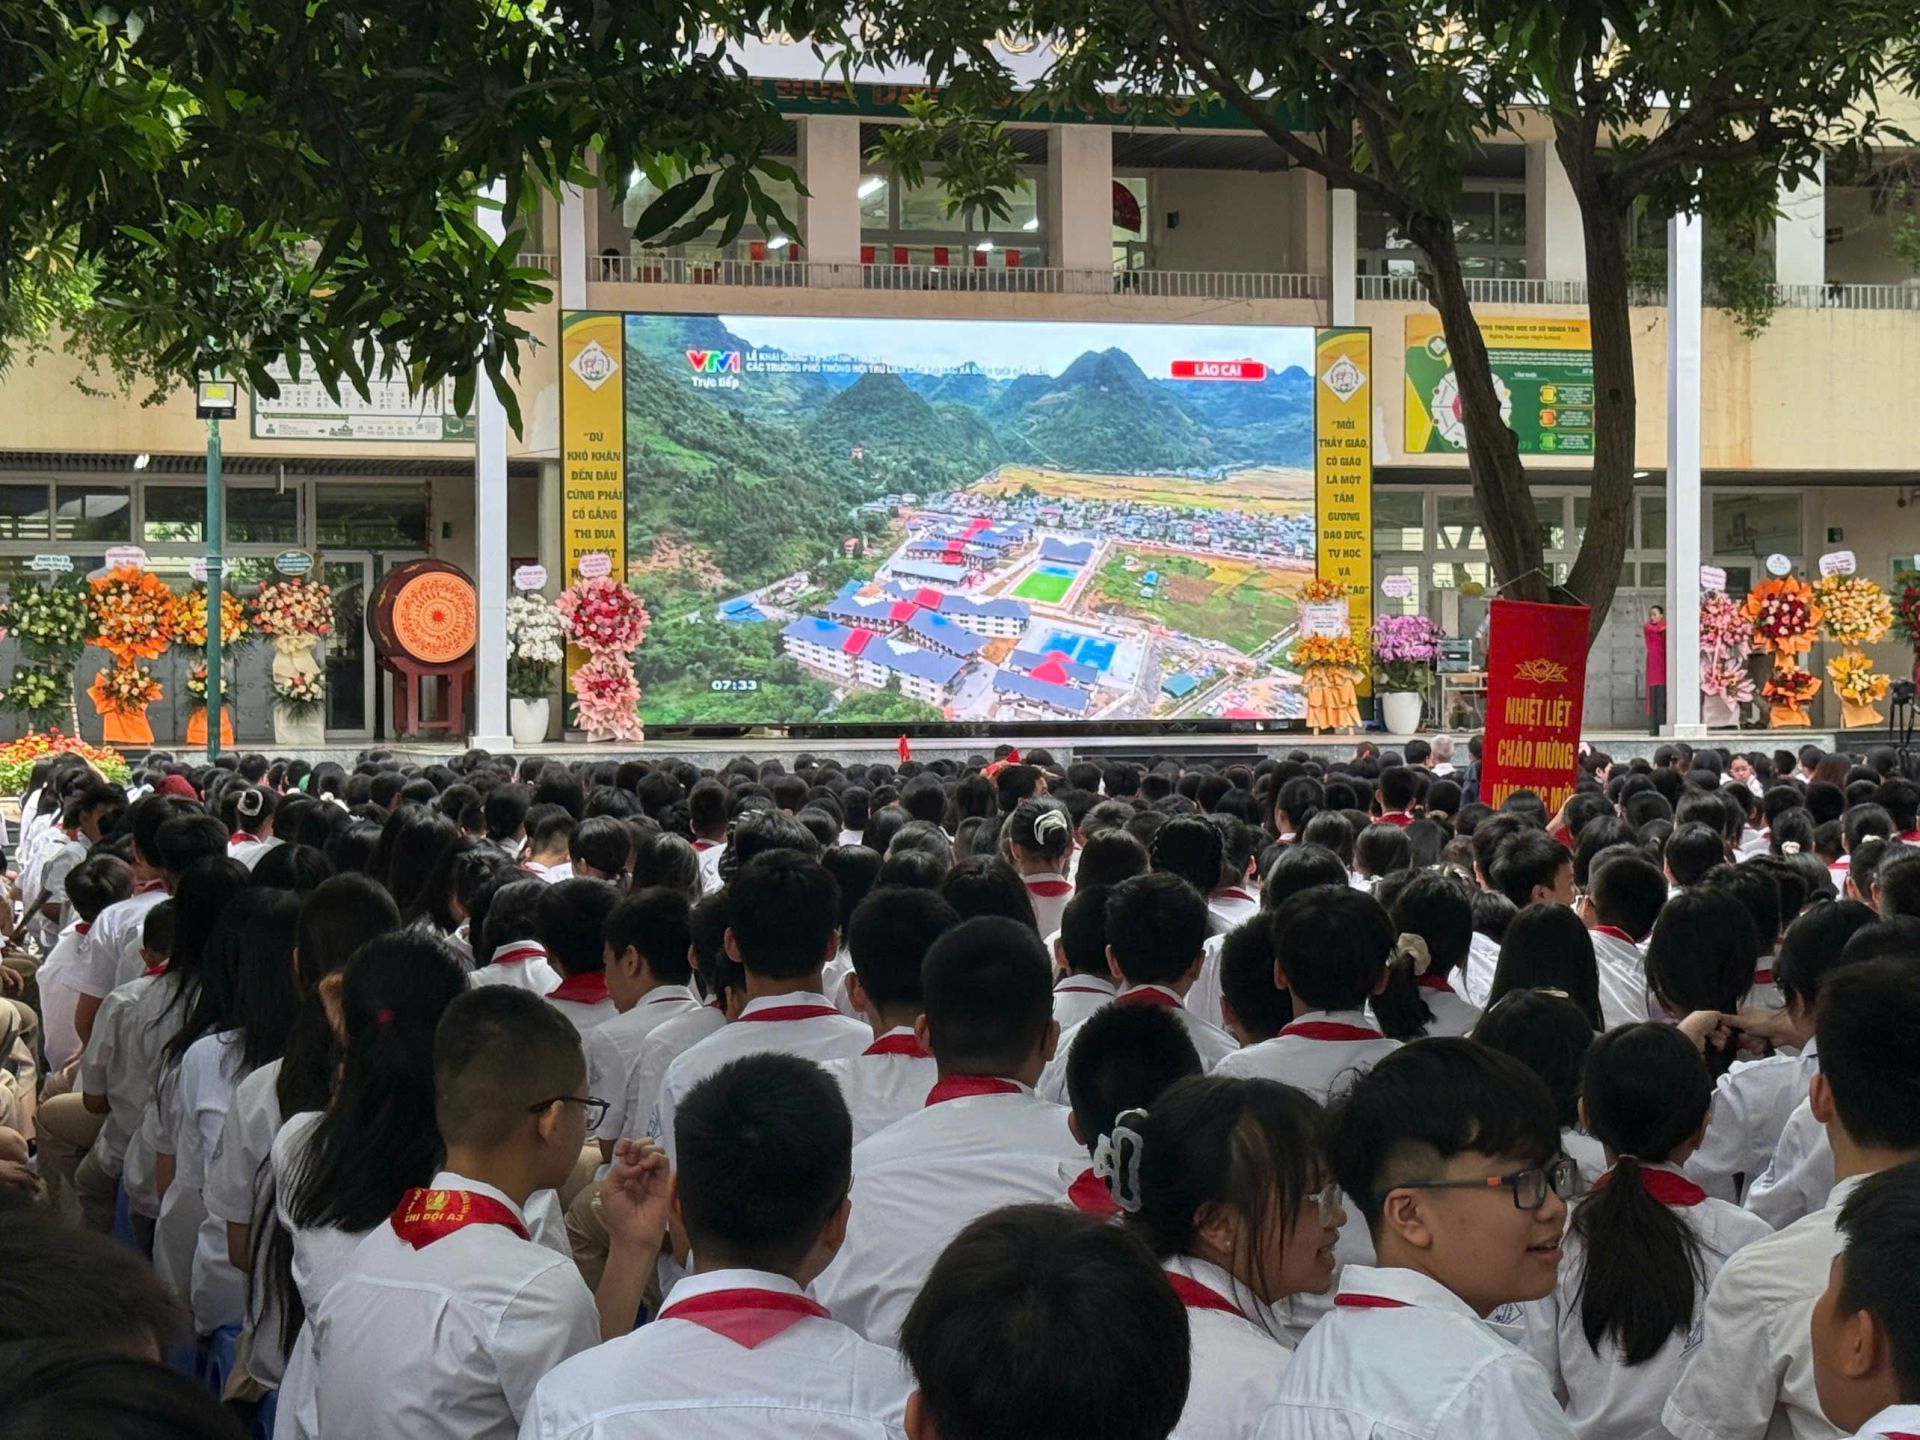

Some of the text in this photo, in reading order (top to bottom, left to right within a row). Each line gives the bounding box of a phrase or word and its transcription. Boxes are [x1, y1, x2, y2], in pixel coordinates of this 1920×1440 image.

[686, 350, 741, 373] VTV1
[1194, 362, 1242, 377] LÀO CAI
[691, 375, 740, 390] Trực tiếp
[574, 529, 591, 539] THI
[711, 680, 758, 690] 07:33
[1505, 692, 1572, 734] NHIỆT LIỆT
[1497, 734, 1574, 770] CHÀO MỪNG
[404, 1211, 465, 1224] CHI ĐỘI A3
